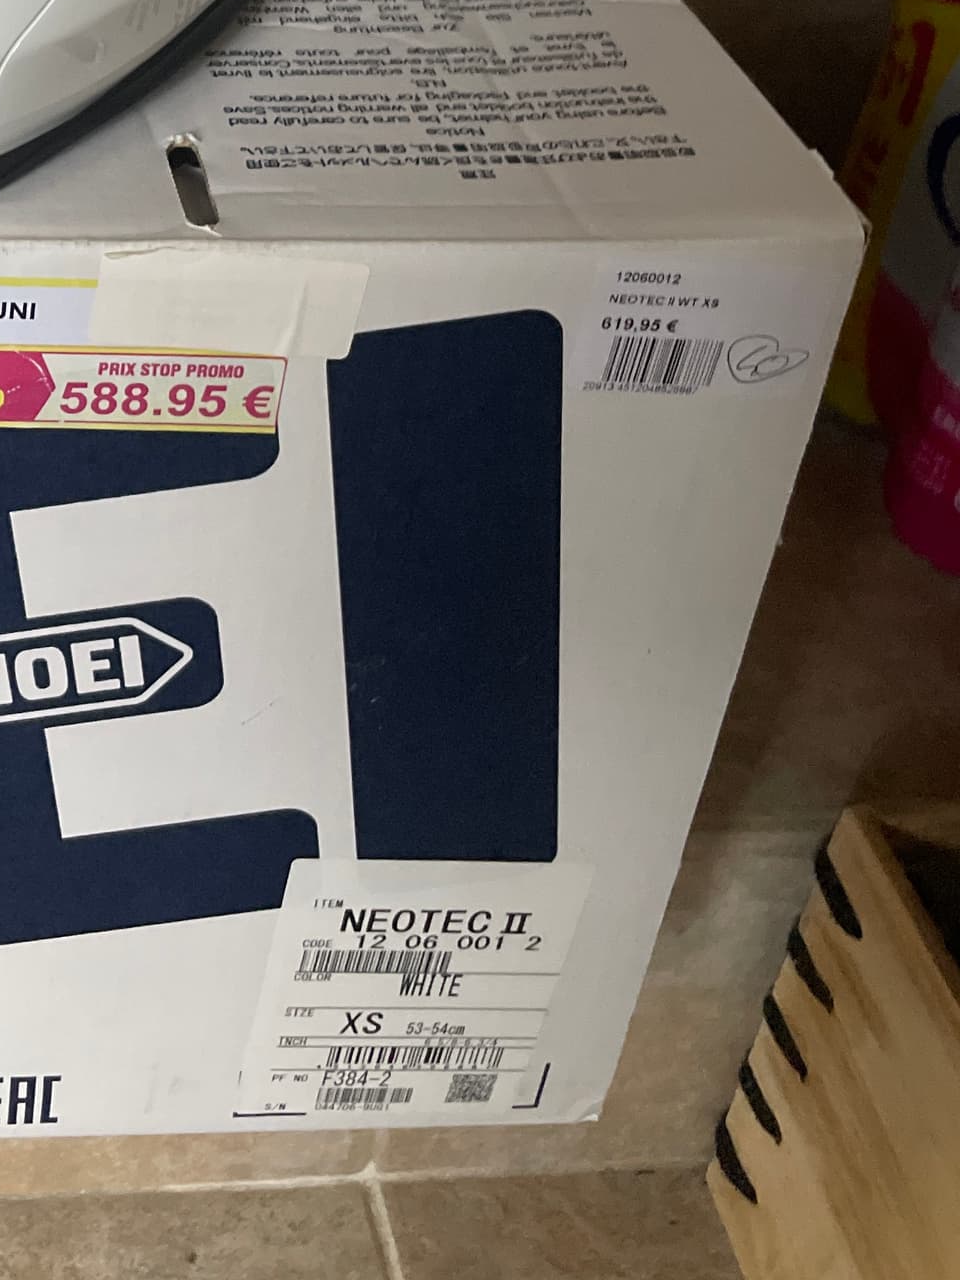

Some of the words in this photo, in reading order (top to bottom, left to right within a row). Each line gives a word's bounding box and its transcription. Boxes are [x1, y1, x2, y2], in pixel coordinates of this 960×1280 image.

[250, 95, 333, 103] reference.
[396, 94, 420, 102] for
[338, 104, 405, 113] warning
[411, 104, 428, 112] all
[228, 118, 267, 126] read
[273, 116, 345, 126] carefully
[350, 116, 368, 124] to
[617, 271, 682, 286] 12060012
[609, 293, 665, 306] NEOTEC
[678, 296, 698, 308] WT
[601, 316, 661, 333] 619,95
[667, 319, 679, 334] €
[97, 361, 136, 377] PRIX
[138, 362, 183, 378] STOP
[185, 363, 245, 380] PROMO
[59, 381, 228, 419] 588.95
[242, 386, 275, 419] €
[314, 899, 344, 909] ITEM
[340, 909, 491, 934] NEOTEC
[302, 939, 333, 948] CODE
[357, 935, 386, 949] 12
[405, 935, 438, 949] 06
[457, 935, 505, 950] 001
[525, 936, 542, 951] 2
[294, 973, 332, 982] COLOR
[399, 973, 463, 997] WHITE
[285, 1008, 314, 1018] SIZE
[340, 1012, 384, 1035] XS
[406, 1022, 466, 1036] 53-54cm
[279, 1036, 308, 1047] INCH
[321, 1071, 392, 1087] F384-2
